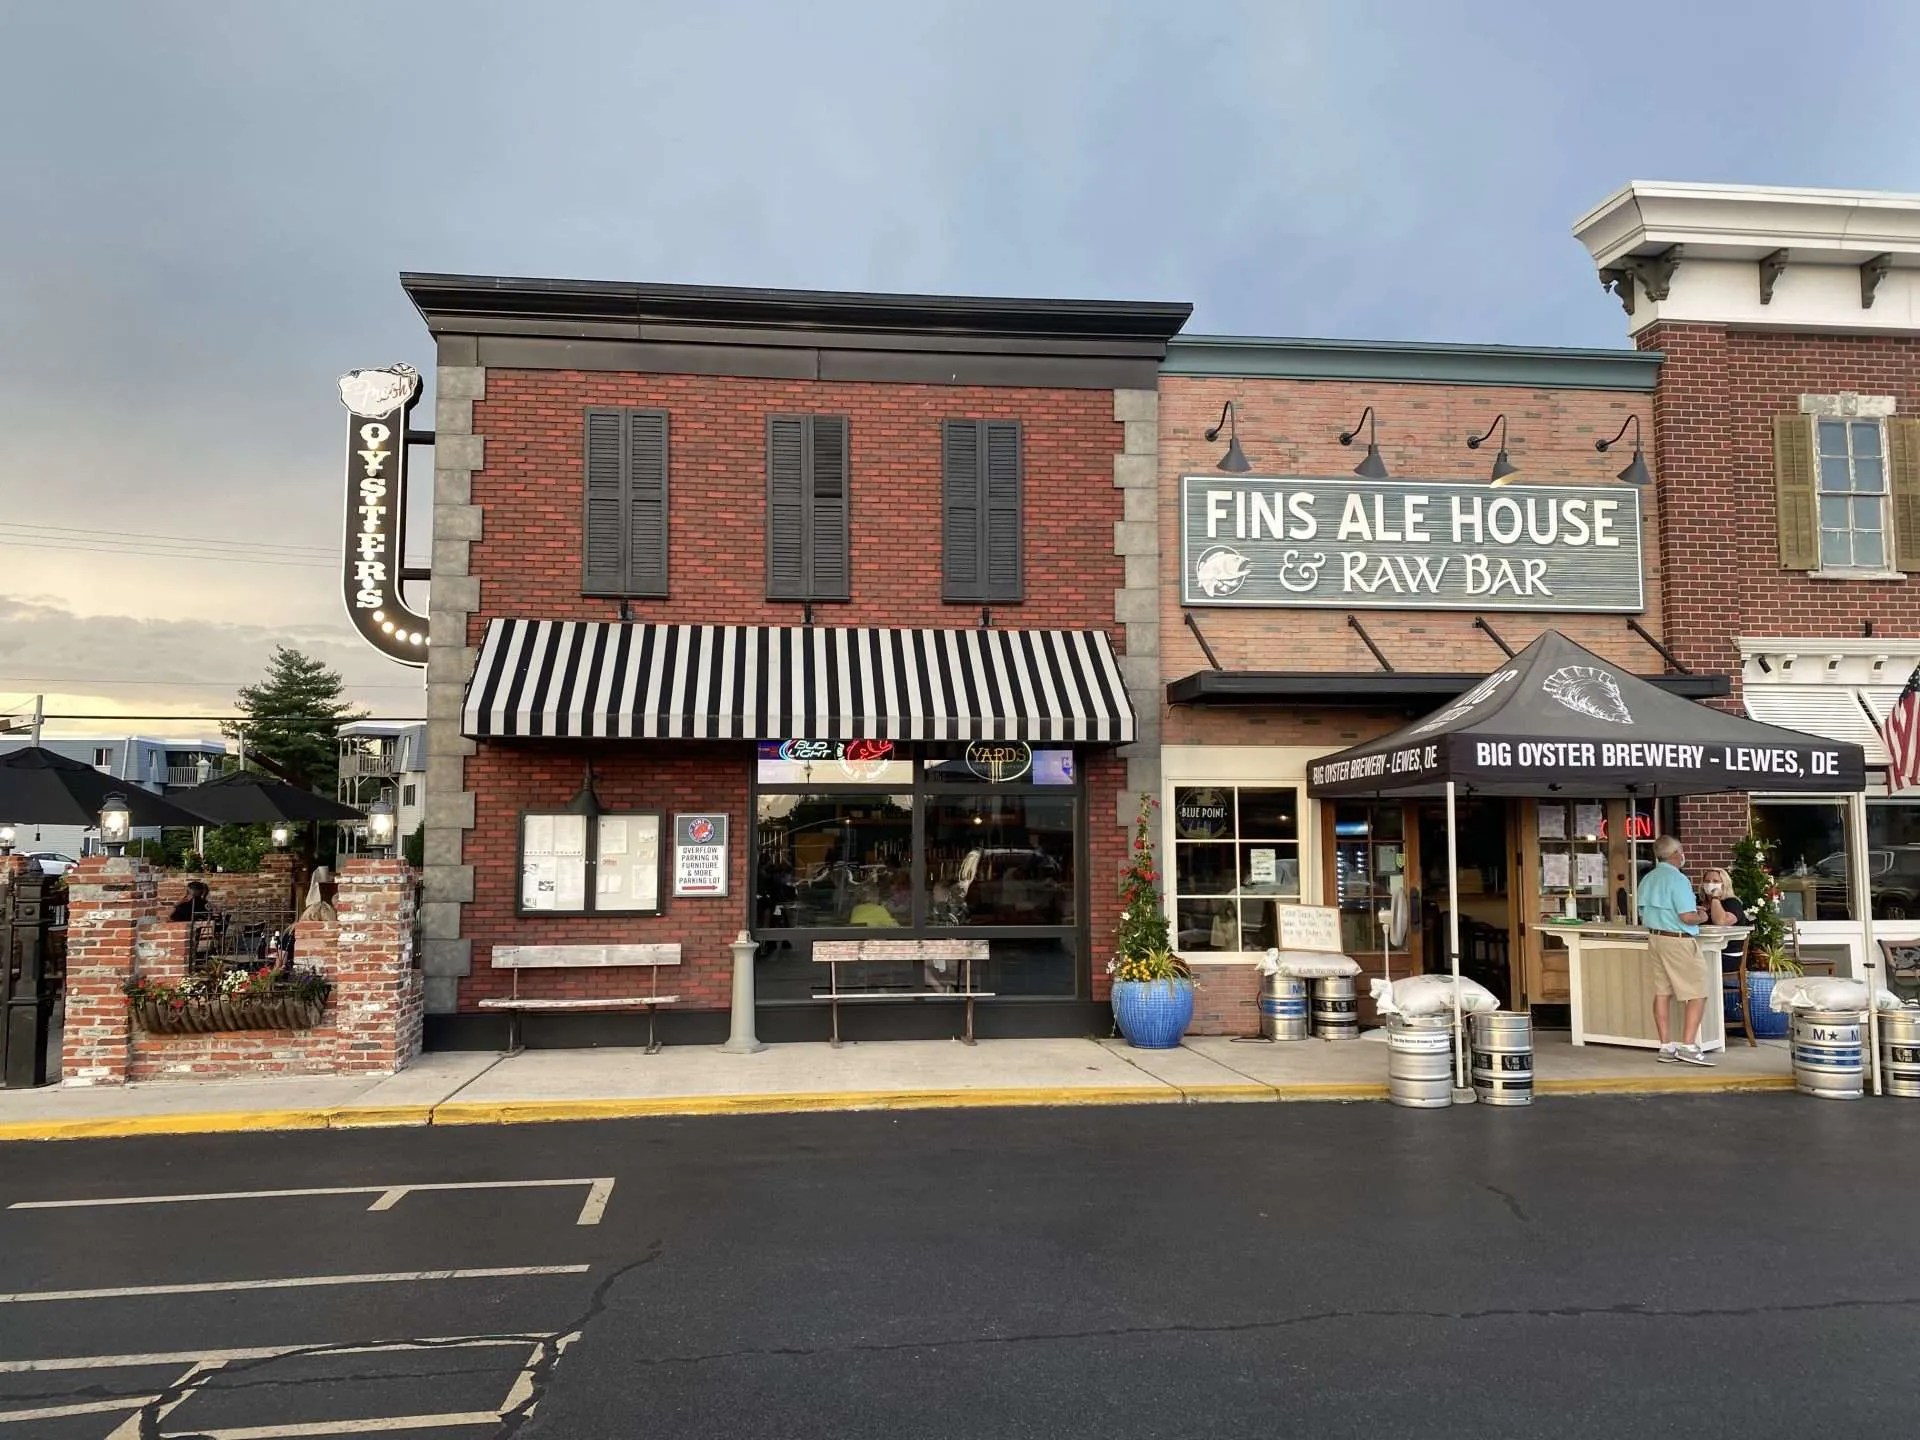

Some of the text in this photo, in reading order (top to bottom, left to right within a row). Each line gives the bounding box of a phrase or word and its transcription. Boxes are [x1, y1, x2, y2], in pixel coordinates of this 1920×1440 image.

[354, 423, 391, 609] OYSTERS
[1206, 490, 1620, 547] FINS ALE HOUSE
[1279, 549, 1553, 596] & RAW BAR
[787, 749, 832, 758] LIGHT
[794, 740, 827, 750] BUD
[971, 747, 1026, 763] YARDS
[1312, 765, 1325, 785] BIG
[1325, 761, 1350, 783] OYSTER
[1350, 753, 1387, 779] BREWERY
[1391, 748, 1423, 774] LEWES,
[1424, 745, 1438, 769] DE
[1476, 742, 1512, 767] BIG
[1518, 743, 1596, 767] OYSTER
[1602, 743, 1704, 769] BREWERY
[1725, 747, 1805, 778] LEWES,
[1811, 751, 1840, 775] DE
[1181, 807, 1224, 818] BLUE POINT
[1813, 1029, 1825, 1040] M
